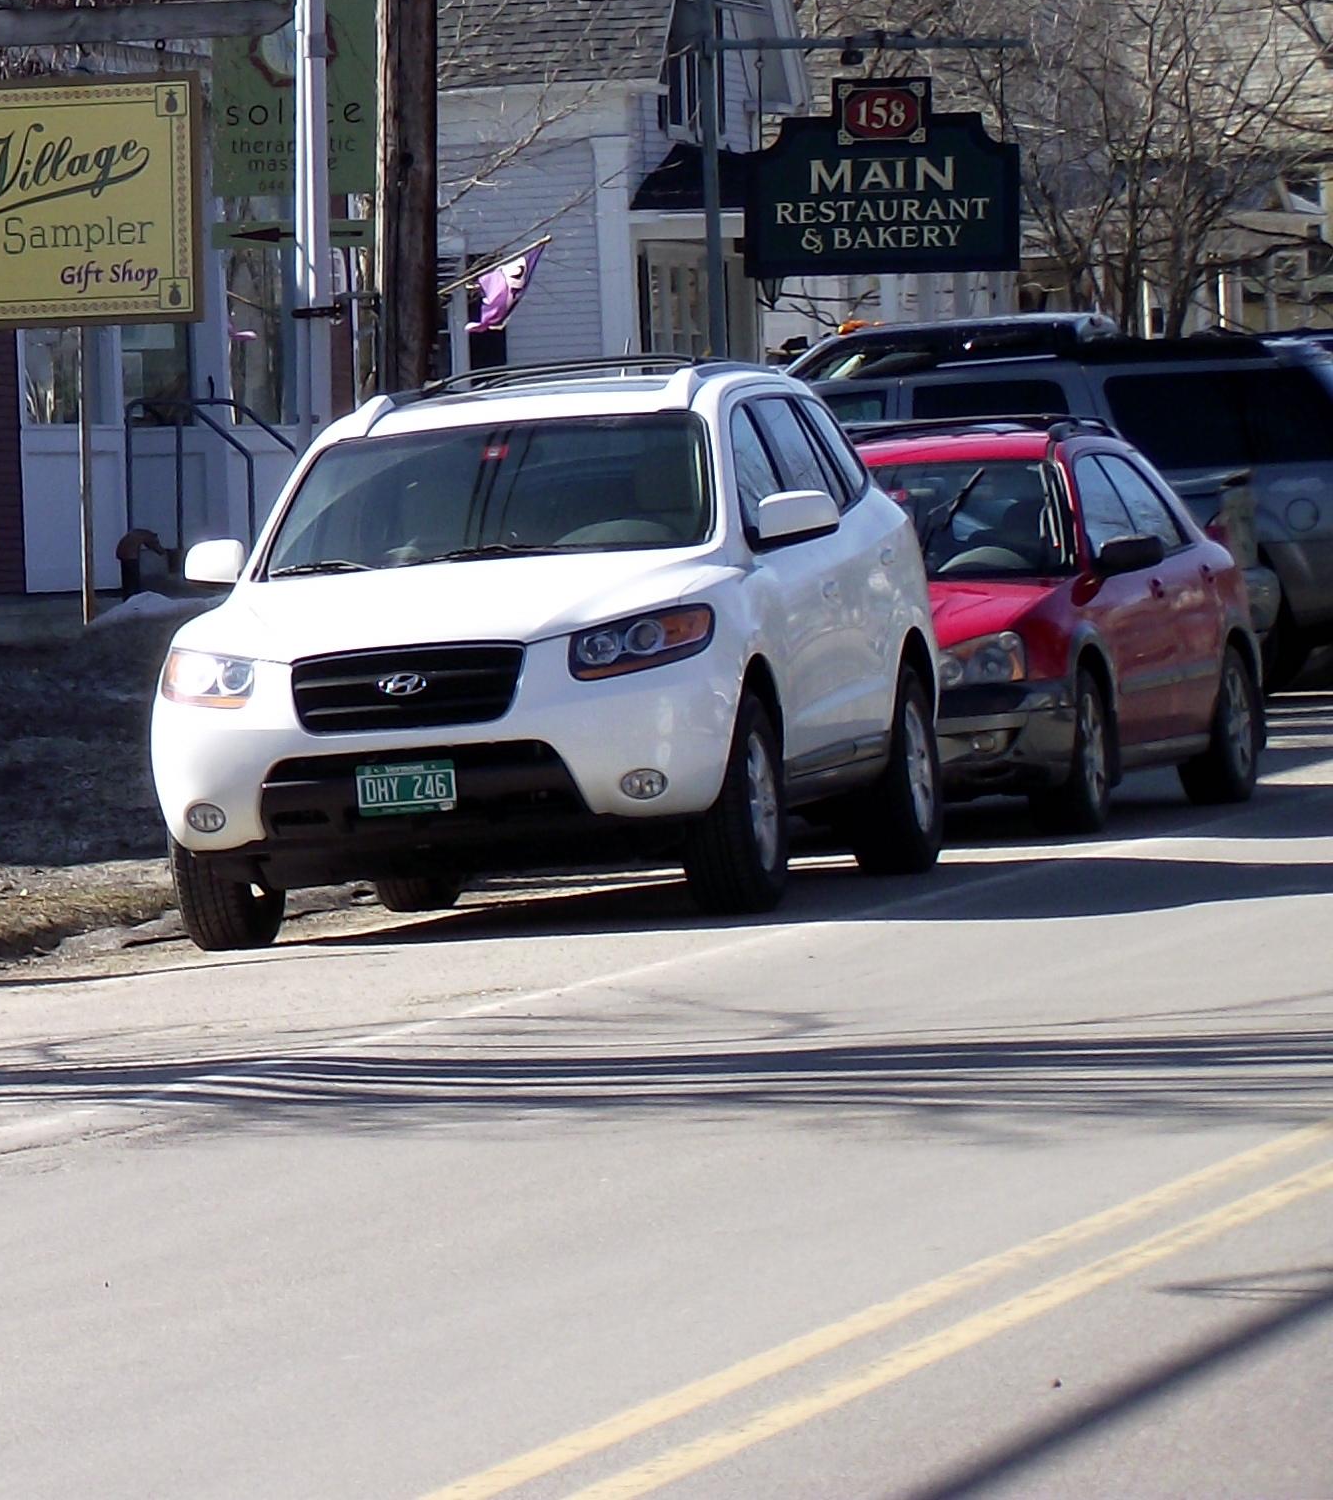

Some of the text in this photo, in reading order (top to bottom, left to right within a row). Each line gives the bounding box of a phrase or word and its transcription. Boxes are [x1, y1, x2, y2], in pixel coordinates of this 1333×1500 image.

[226, 97, 362, 126] sole
[856, 97, 906, 129] 158
[809, 155, 956, 195] MAIN
[775, 197, 990, 225] RESTAURANT
[3, 216, 154, 255] Sampler
[801, 224, 962, 254] & BAKERY
[60, 258, 159, 293] Gift Shop
[365, 773, 447, 803] DHY 246
